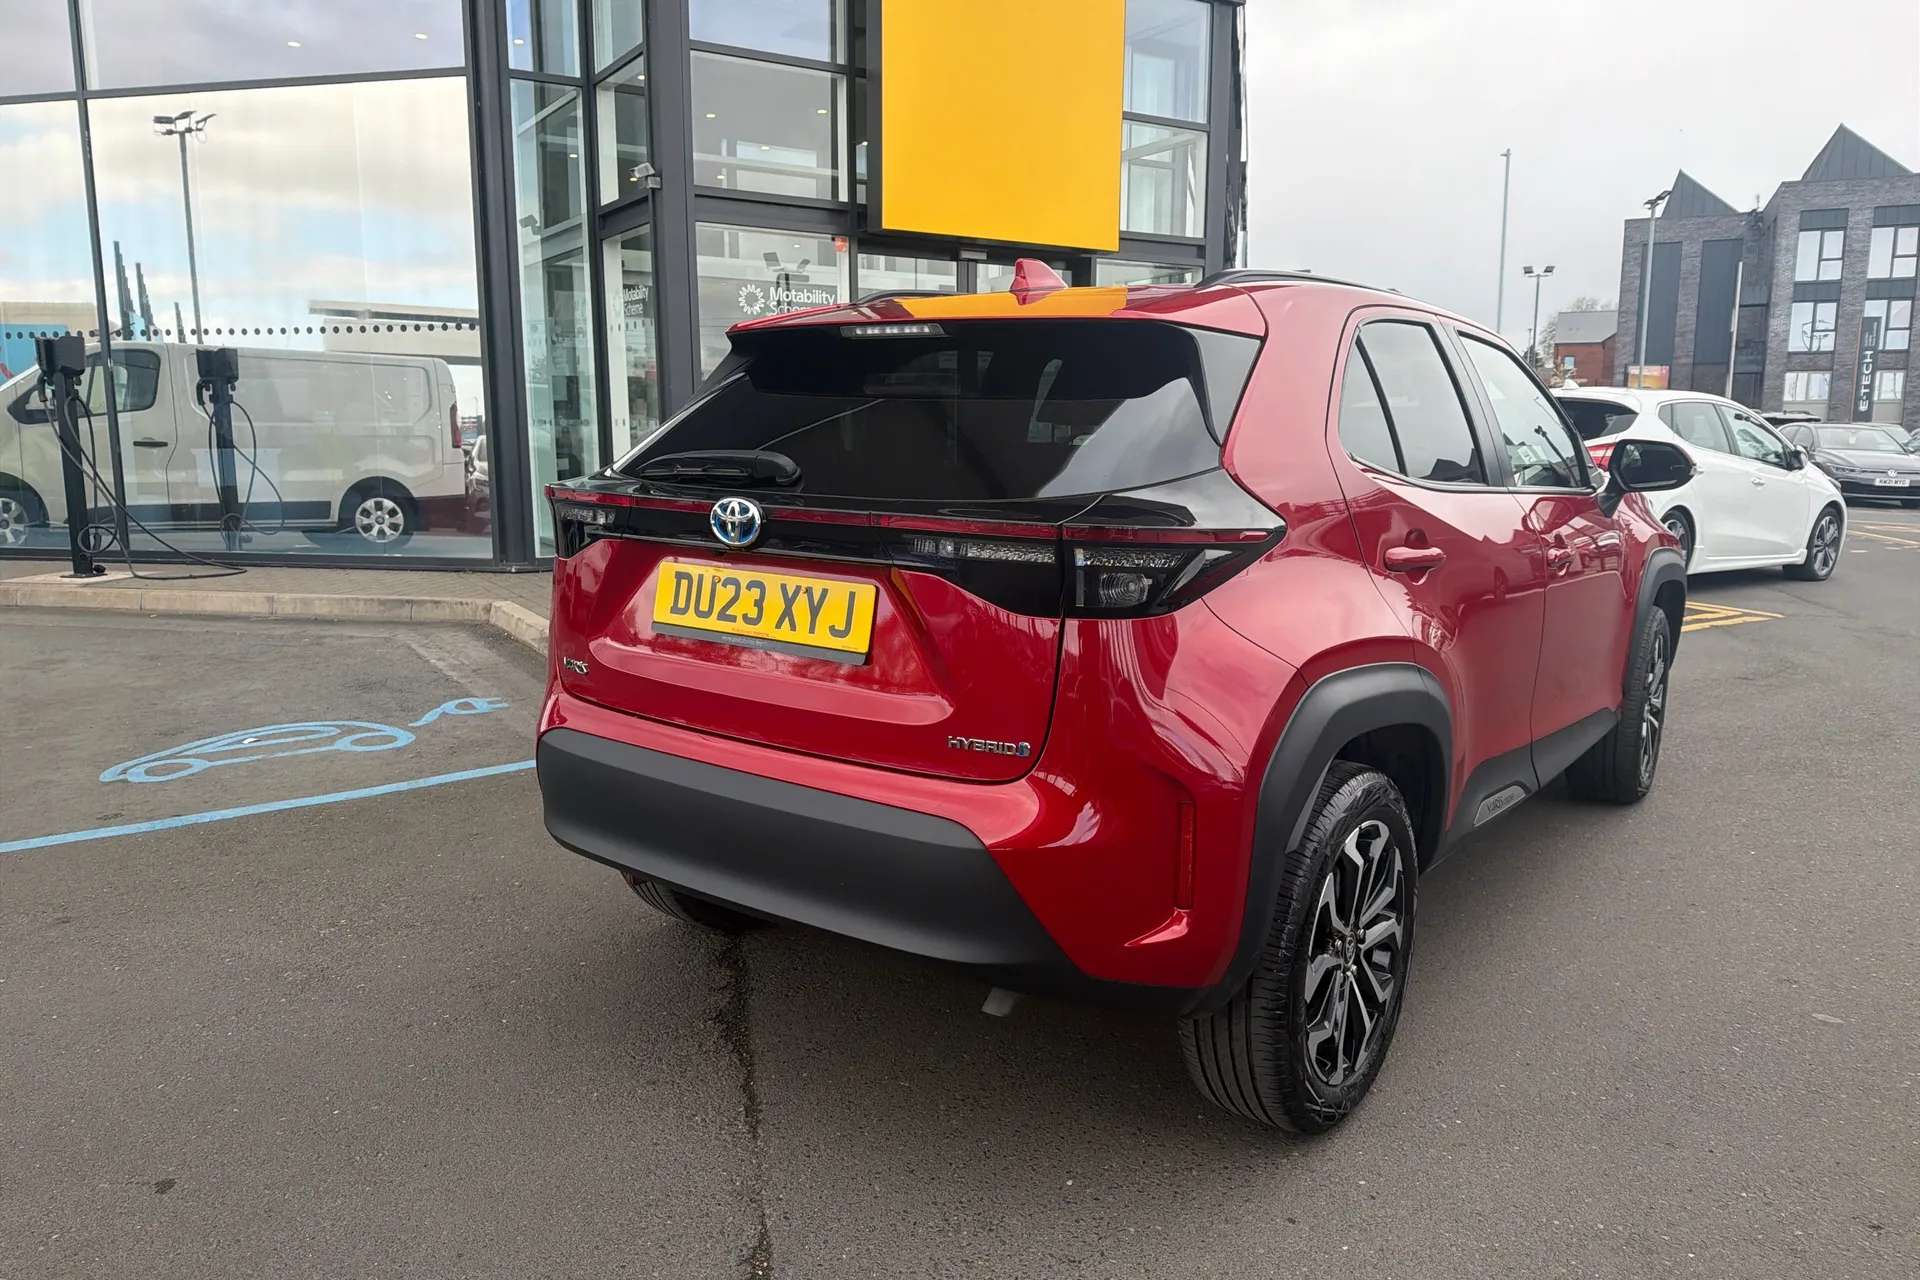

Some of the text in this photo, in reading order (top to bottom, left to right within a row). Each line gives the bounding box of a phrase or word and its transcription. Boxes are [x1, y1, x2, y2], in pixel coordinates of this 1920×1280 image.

[769, 286, 835, 305] Motability
[670, 571, 856, 638] DU23 XYJ
[948, 735, 1016, 755] HYBRID
